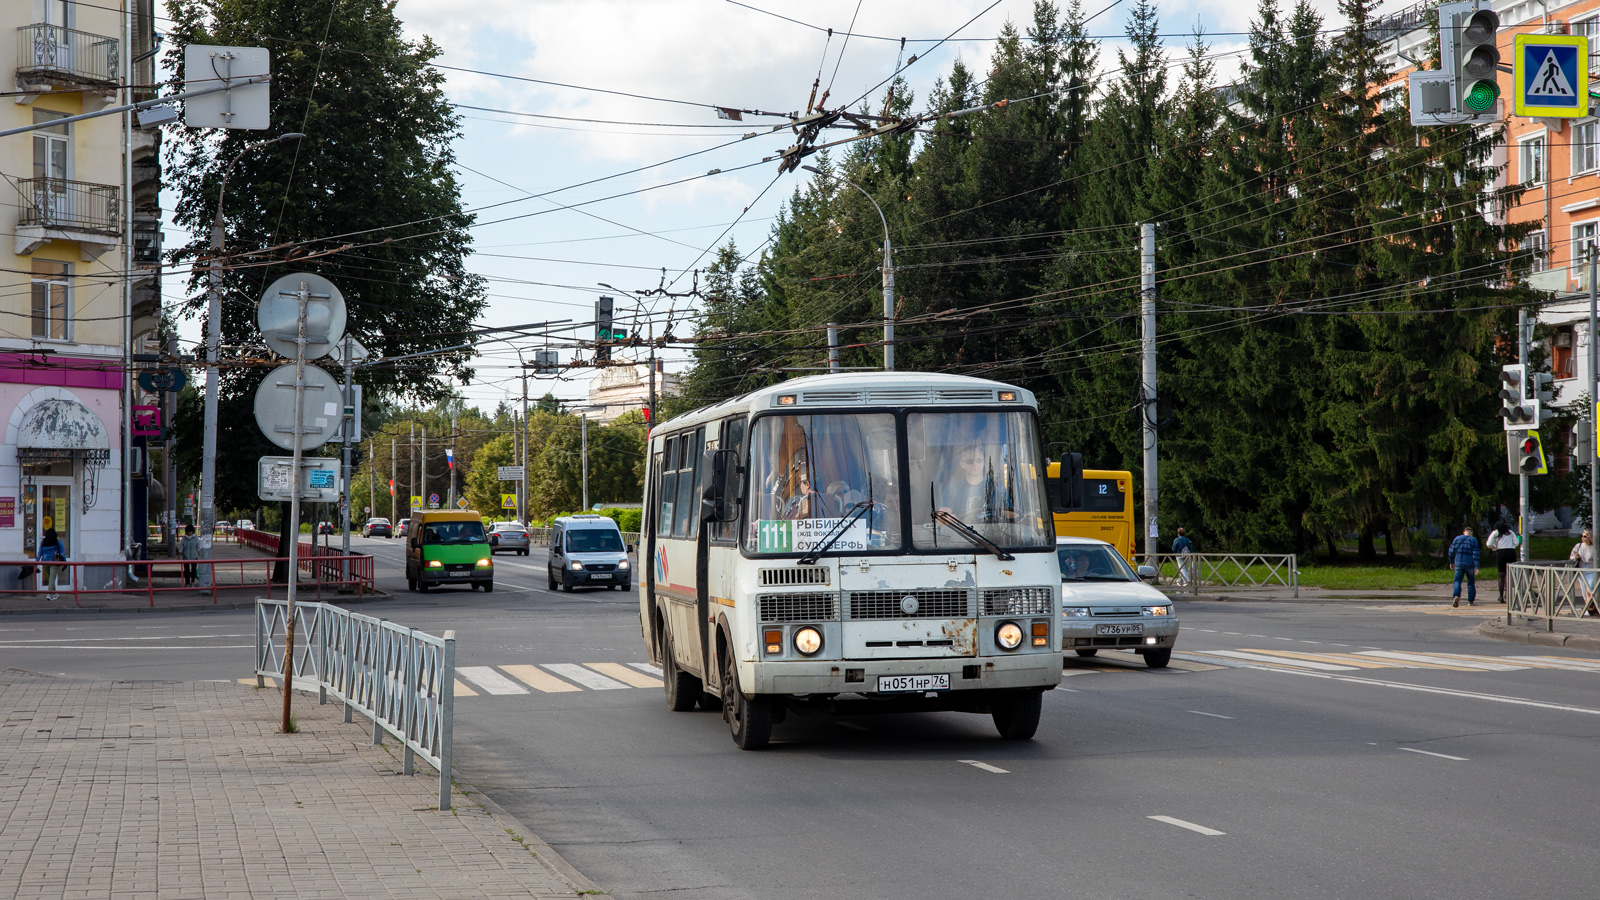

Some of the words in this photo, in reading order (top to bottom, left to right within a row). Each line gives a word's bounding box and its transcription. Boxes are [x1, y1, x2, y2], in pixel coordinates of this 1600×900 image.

[1099, 484, 1107, 494] 12
[796, 519, 857, 529] РЫБИНСК
[762, 523, 787, 549] 111
[797, 541, 864, 550] СУДОВЕРФЬ
[1100, 626, 1131, 634] С736УР
[884, 678, 930, 689] Н051НР
[933, 676, 945, 685] 76
